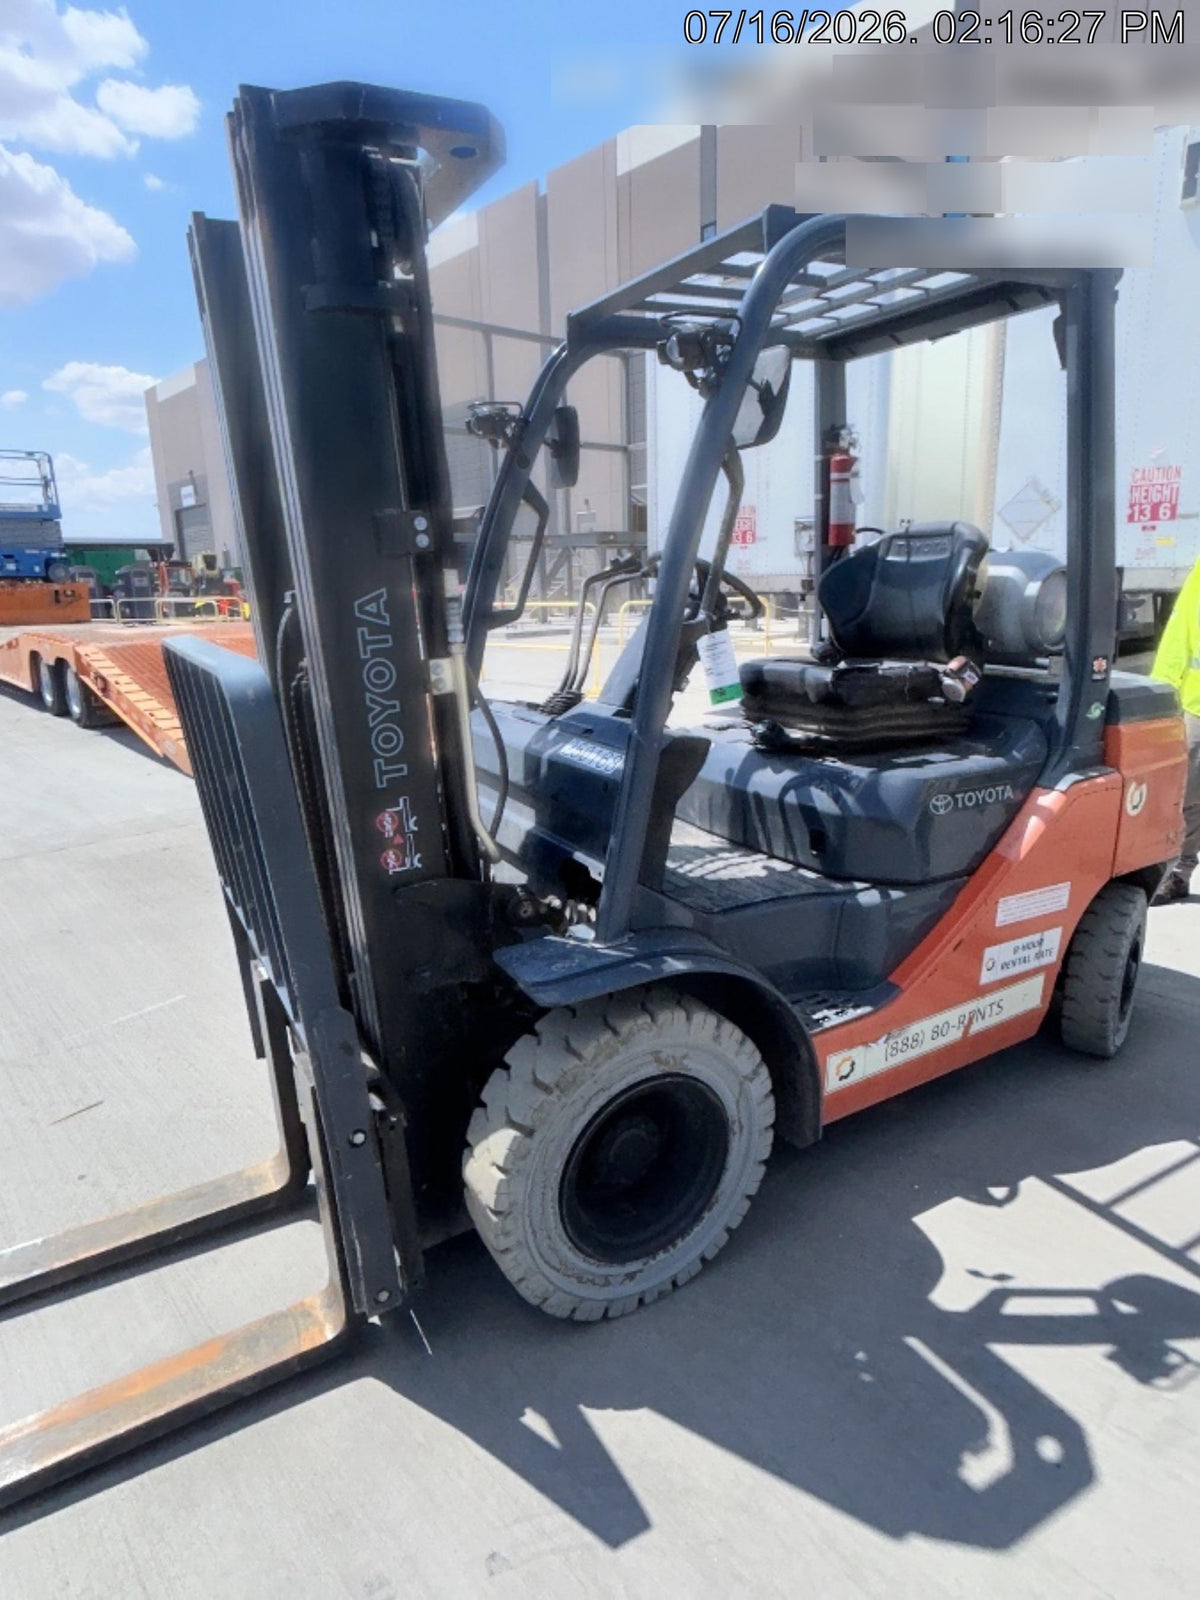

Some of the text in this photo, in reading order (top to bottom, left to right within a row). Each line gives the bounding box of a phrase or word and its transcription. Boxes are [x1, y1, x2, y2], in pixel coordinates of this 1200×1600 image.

[1131, 466, 1182, 483] CAUTION
[1130, 483, 1180, 504] HEIGHT
[1132, 503, 1171, 522] 13 6
[354, 587, 408, 788] TOYOTA
[954, 785, 1014, 808] TOYOTA
[1000, 955, 1031, 971] RENTAL
[884, 1028, 926, 1062] (888)
